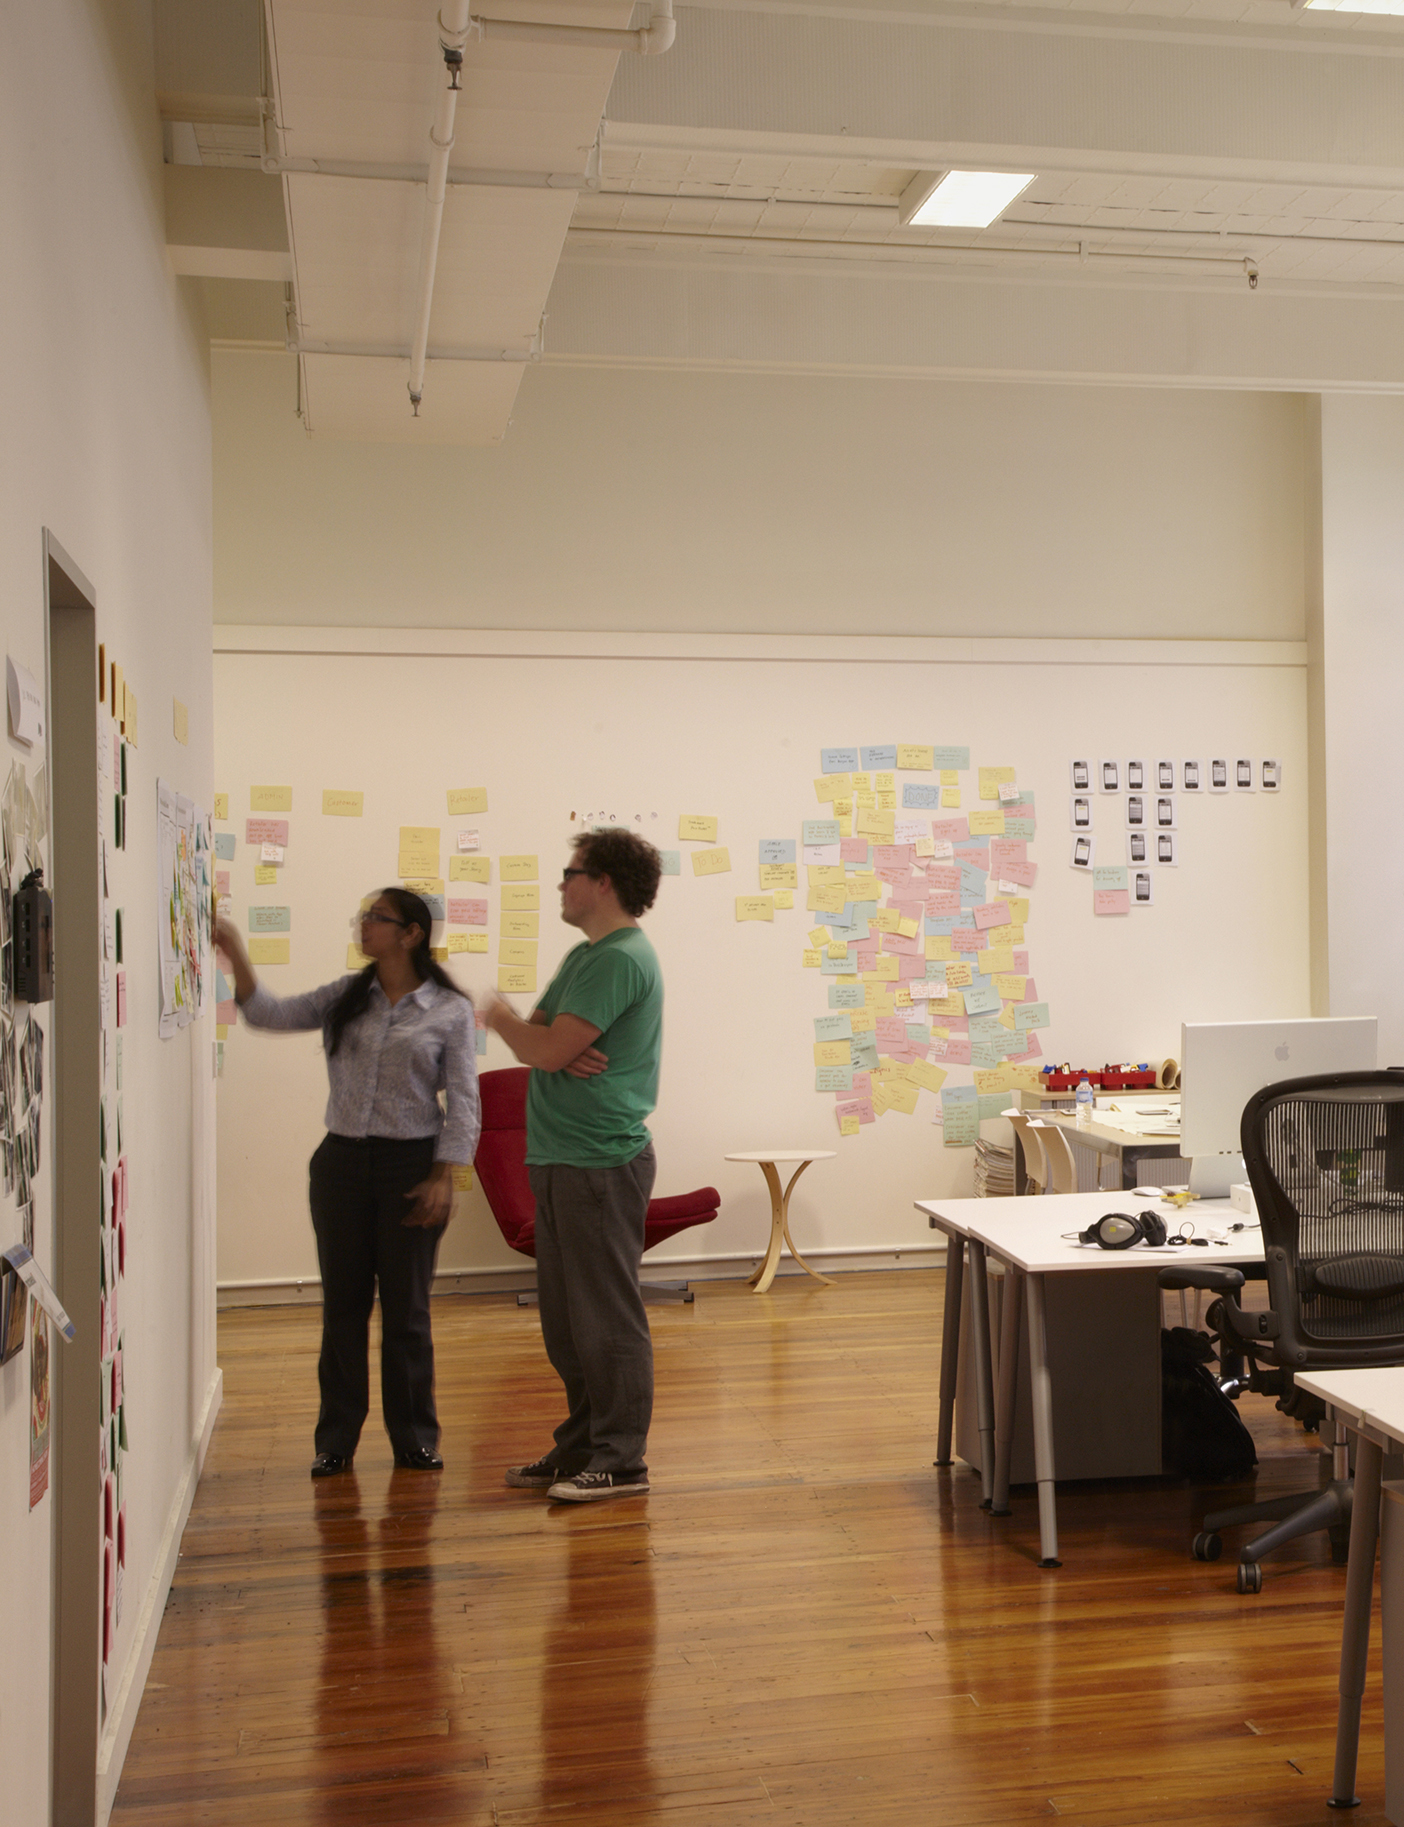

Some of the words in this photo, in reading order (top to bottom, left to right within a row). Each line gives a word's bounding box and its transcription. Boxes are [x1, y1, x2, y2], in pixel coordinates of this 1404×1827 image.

[908, 791, 934, 802] DONE
[694, 856, 706, 868] To
[710, 853, 723, 865] Do
